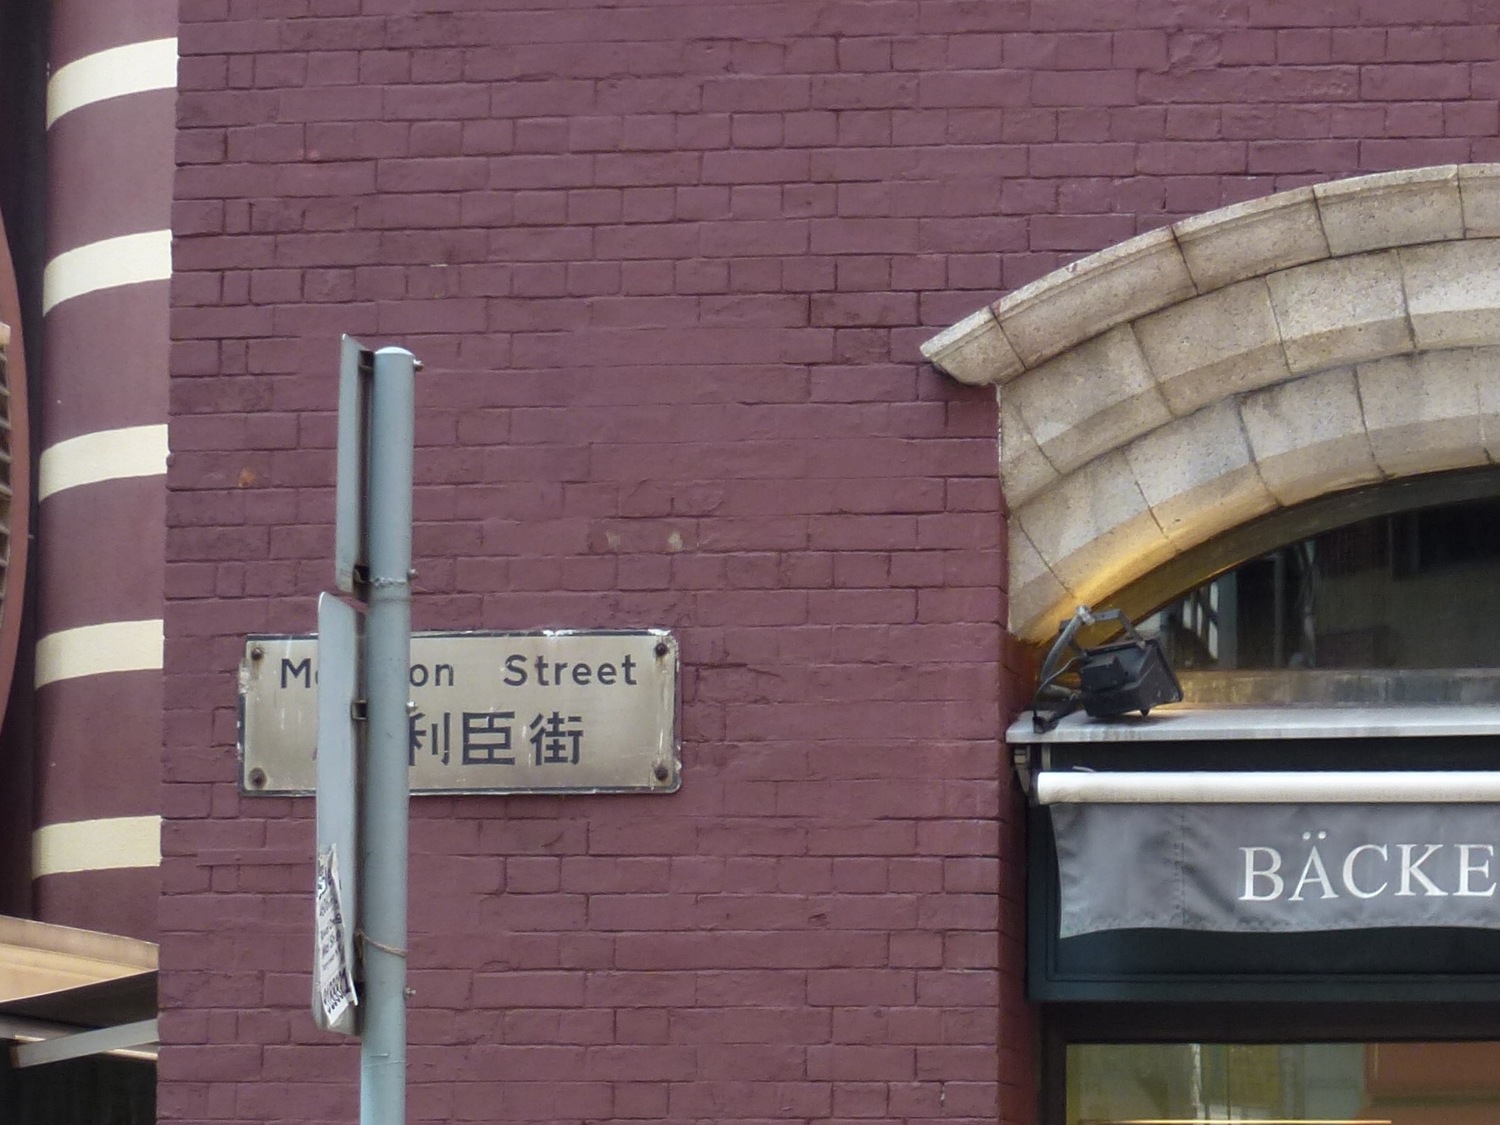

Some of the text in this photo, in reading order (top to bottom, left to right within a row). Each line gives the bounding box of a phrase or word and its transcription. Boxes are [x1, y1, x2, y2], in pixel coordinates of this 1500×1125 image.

[503, 655, 638, 686] Street
[312, 709, 584, 766] 利臣街
